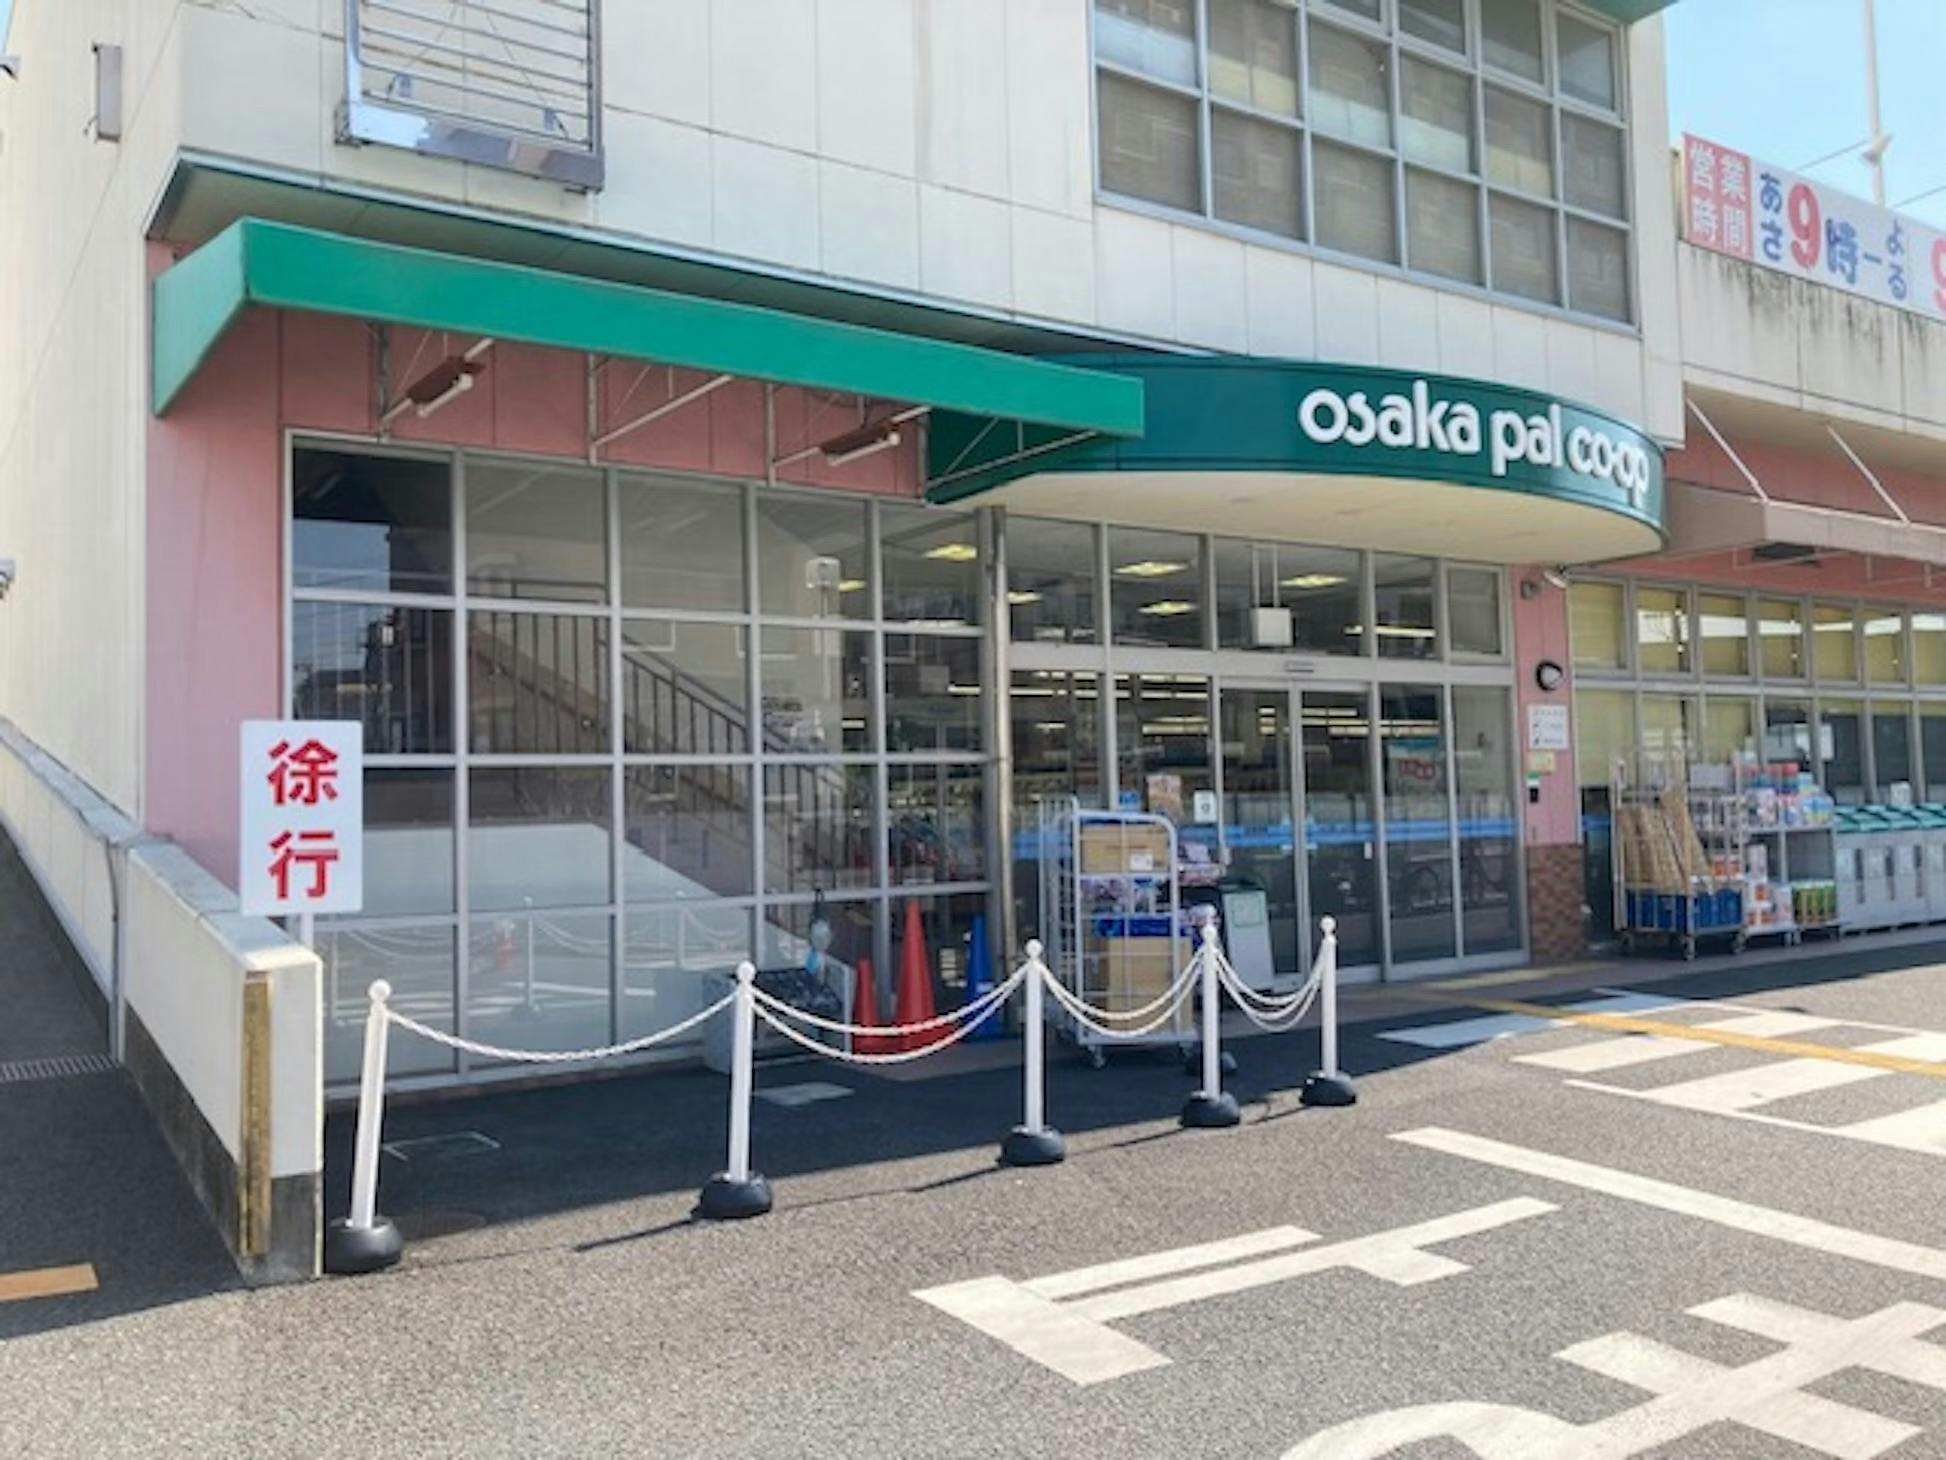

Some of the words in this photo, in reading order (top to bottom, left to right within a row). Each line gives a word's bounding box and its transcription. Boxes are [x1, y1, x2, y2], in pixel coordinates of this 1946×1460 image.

[1760, 172, 1783, 262] あさ
[1886, 218, 1907, 300] よる
[1299, 379, 1480, 455] osaka
[1490, 403, 1563, 477] pal
[266, 738, 339, 900] 徐行
